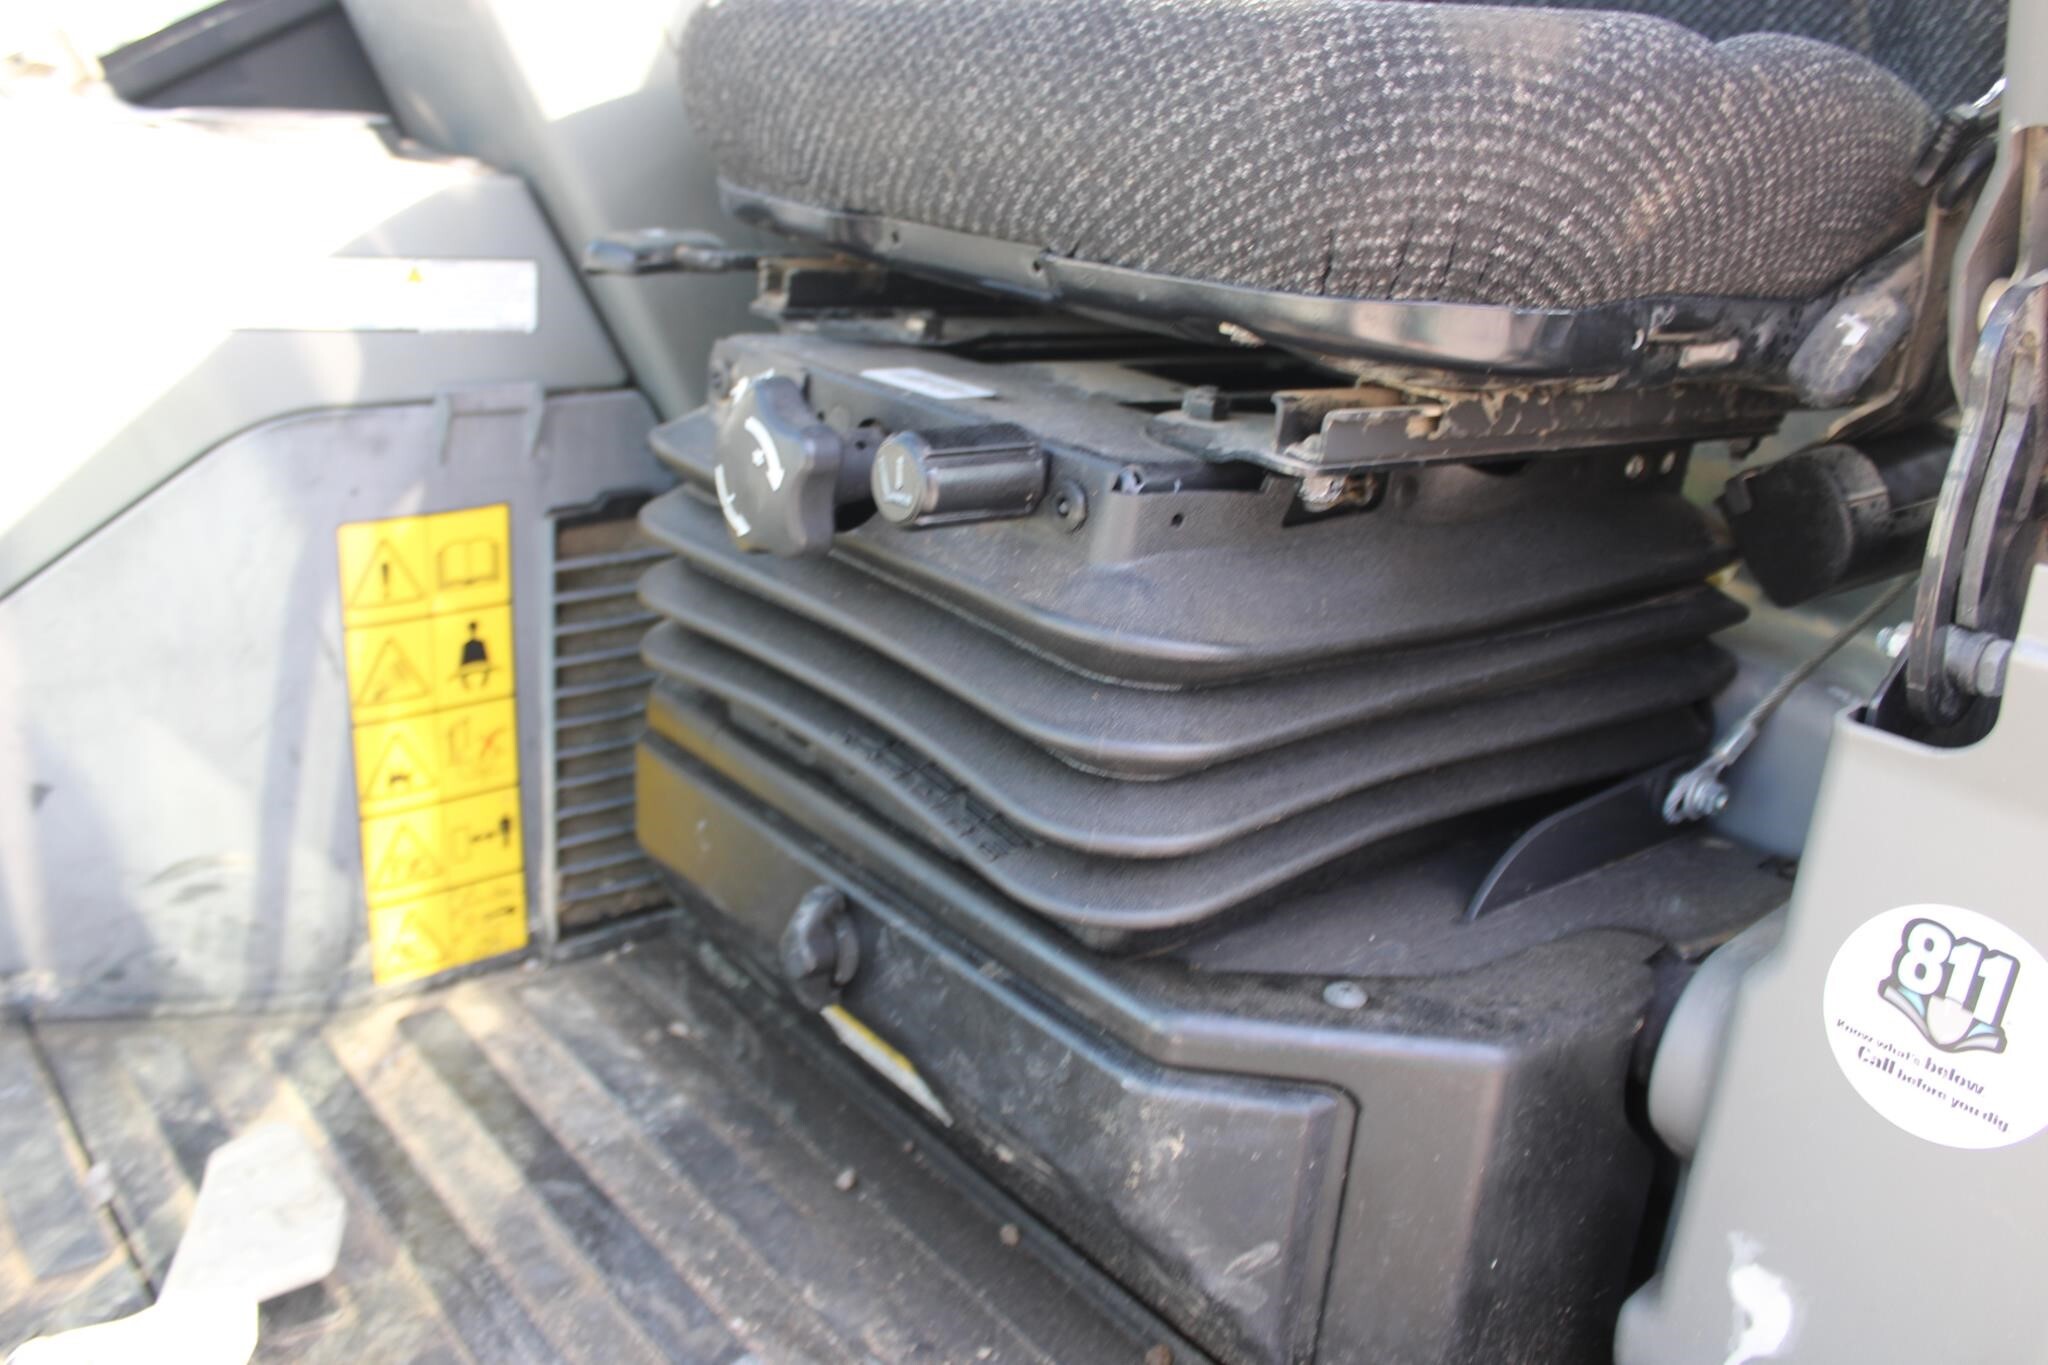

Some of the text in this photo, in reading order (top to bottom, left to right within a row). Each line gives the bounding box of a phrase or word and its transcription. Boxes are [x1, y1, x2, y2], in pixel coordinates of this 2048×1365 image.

[1892, 918, 2020, 1027] 811
[1858, 1046, 2008, 1133] Call before you dig
